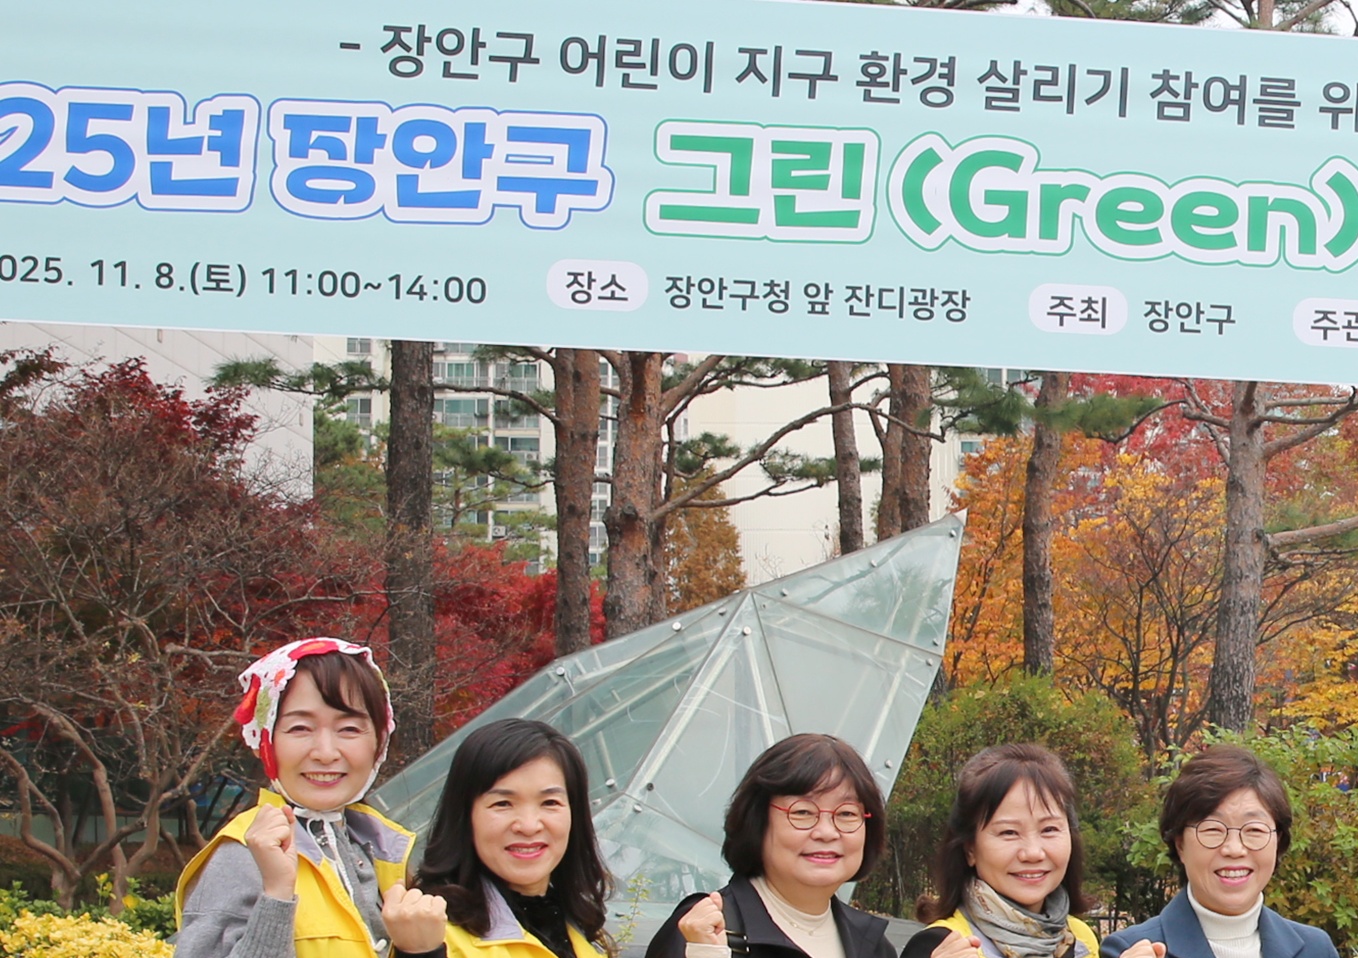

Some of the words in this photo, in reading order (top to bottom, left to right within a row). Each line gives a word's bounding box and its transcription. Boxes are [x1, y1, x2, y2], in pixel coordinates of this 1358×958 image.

[379, 24, 541, 83] 장안구
[559, 34, 714, 94] 어린이
[735, 45, 839, 100] 지구
[855, 50, 956, 108] 환경
[976, 59, 1129, 118] 살리기
[1149, 69, 1302, 129] 참여를
[282, 112, 602, 215] 장안구
[90, 259, 141, 290] 11.
[154, 261, 247, 298] 8.(토)
[261, 267, 487, 304] 11:00~14:00
[566, 270, 629, 305] 장소
[664, 275, 790, 314] 장안구청
[803, 282, 834, 315] 앞
[844, 284, 971, 323] 잔디광장
[1046, 295, 1107, 329] 주최
[1143, 300, 1236, 335] 장안구
